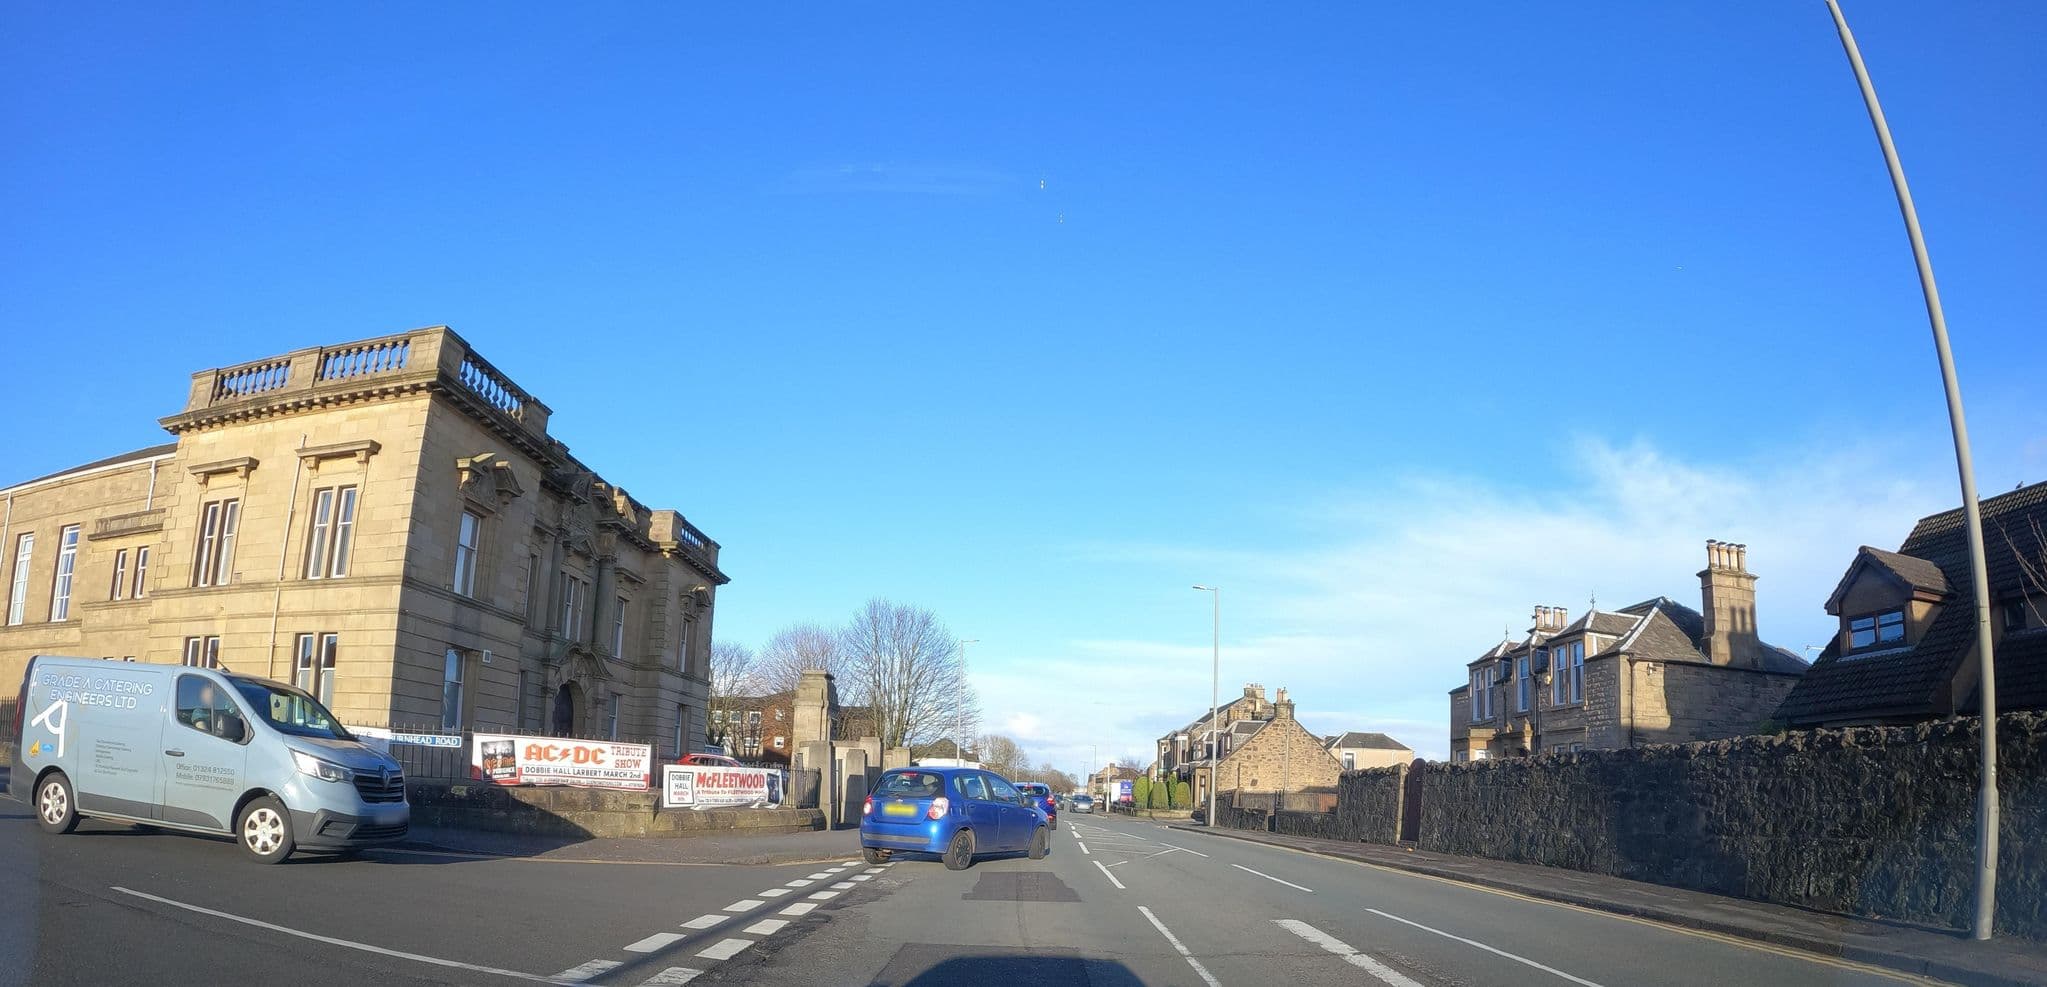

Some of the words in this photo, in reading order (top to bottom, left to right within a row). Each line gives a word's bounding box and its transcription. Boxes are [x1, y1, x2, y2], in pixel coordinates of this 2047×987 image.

[43, 674, 81, 688] GRADE
[94, 678, 153, 695] CATERING
[50, 689, 112, 706] ENGINEERS
[114, 695, 137, 709] LTD
[435, 737, 458, 746] ROAD
[610, 746, 647, 757] TRIBUTE
[615, 759, 642, 769] SHOW
[525, 766, 551, 774] DOBBIE
[553, 767, 571, 775] HALL
[573, 769, 601, 777] LARBERT
[696, 771, 765, 788] McFLEETWOOD
